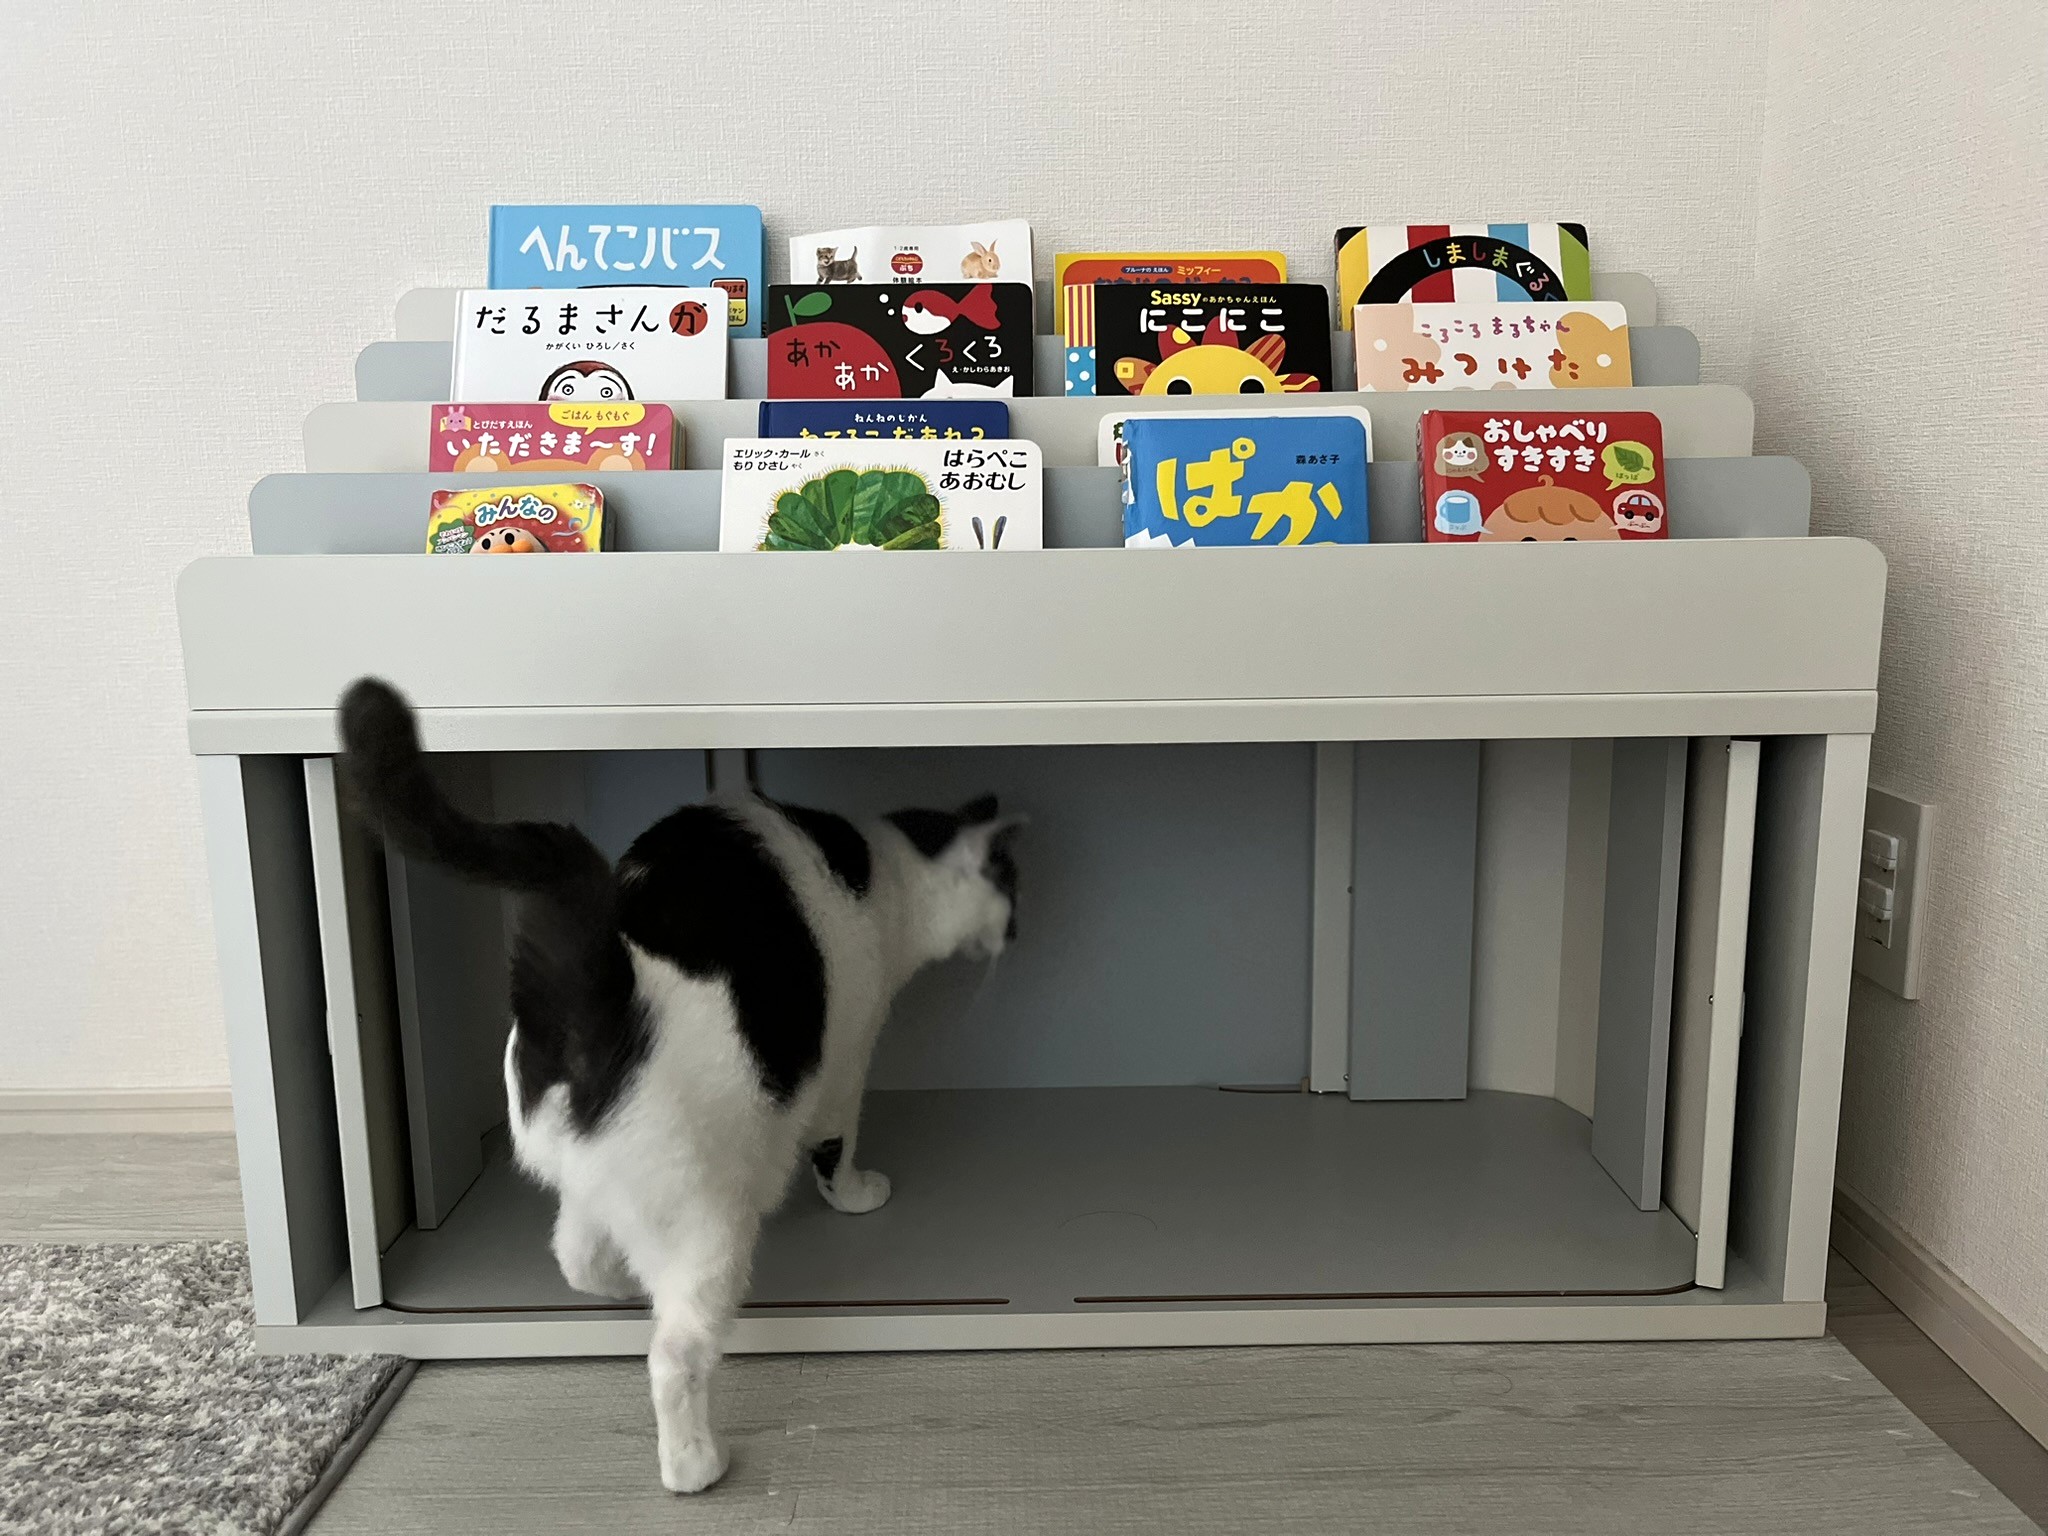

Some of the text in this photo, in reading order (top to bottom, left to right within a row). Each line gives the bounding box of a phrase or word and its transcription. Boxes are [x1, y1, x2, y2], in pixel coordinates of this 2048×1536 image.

[519, 225, 726, 272] へんてこバス
[1177, 265, 1221, 276] ミッフィー
[1150, 289, 1202, 307] Sassy
[476, 303, 708, 335] だるまさんが
[1140, 308, 1286, 334] にこにこ
[1421, 315, 1571, 343] ころころ まるちゃん
[546, 342, 581, 351] かがくい
[1401, 348, 1568, 385] みつけた
[473, 420, 533, 430] とびだすえほん
[561, 409, 630, 421] ごはん もぐもぐ
[854, 413, 928, 423] ねんねのじかん
[1483, 418, 1608, 443] おしゃべり
[733, 449, 811, 459] エリック・カール
[943, 449, 1028, 469] はらぺこ
[1295, 454, 1340, 465] 森あさ子
[1493, 445, 1596, 473] すきすき
[733, 461, 753, 471] もり
[757, 461, 789, 471] ひさし
[938, 471, 1026, 491] あおむし
[1156, 437, 1343, 545] ぱか
[477, 497, 554, 524] みんなの
